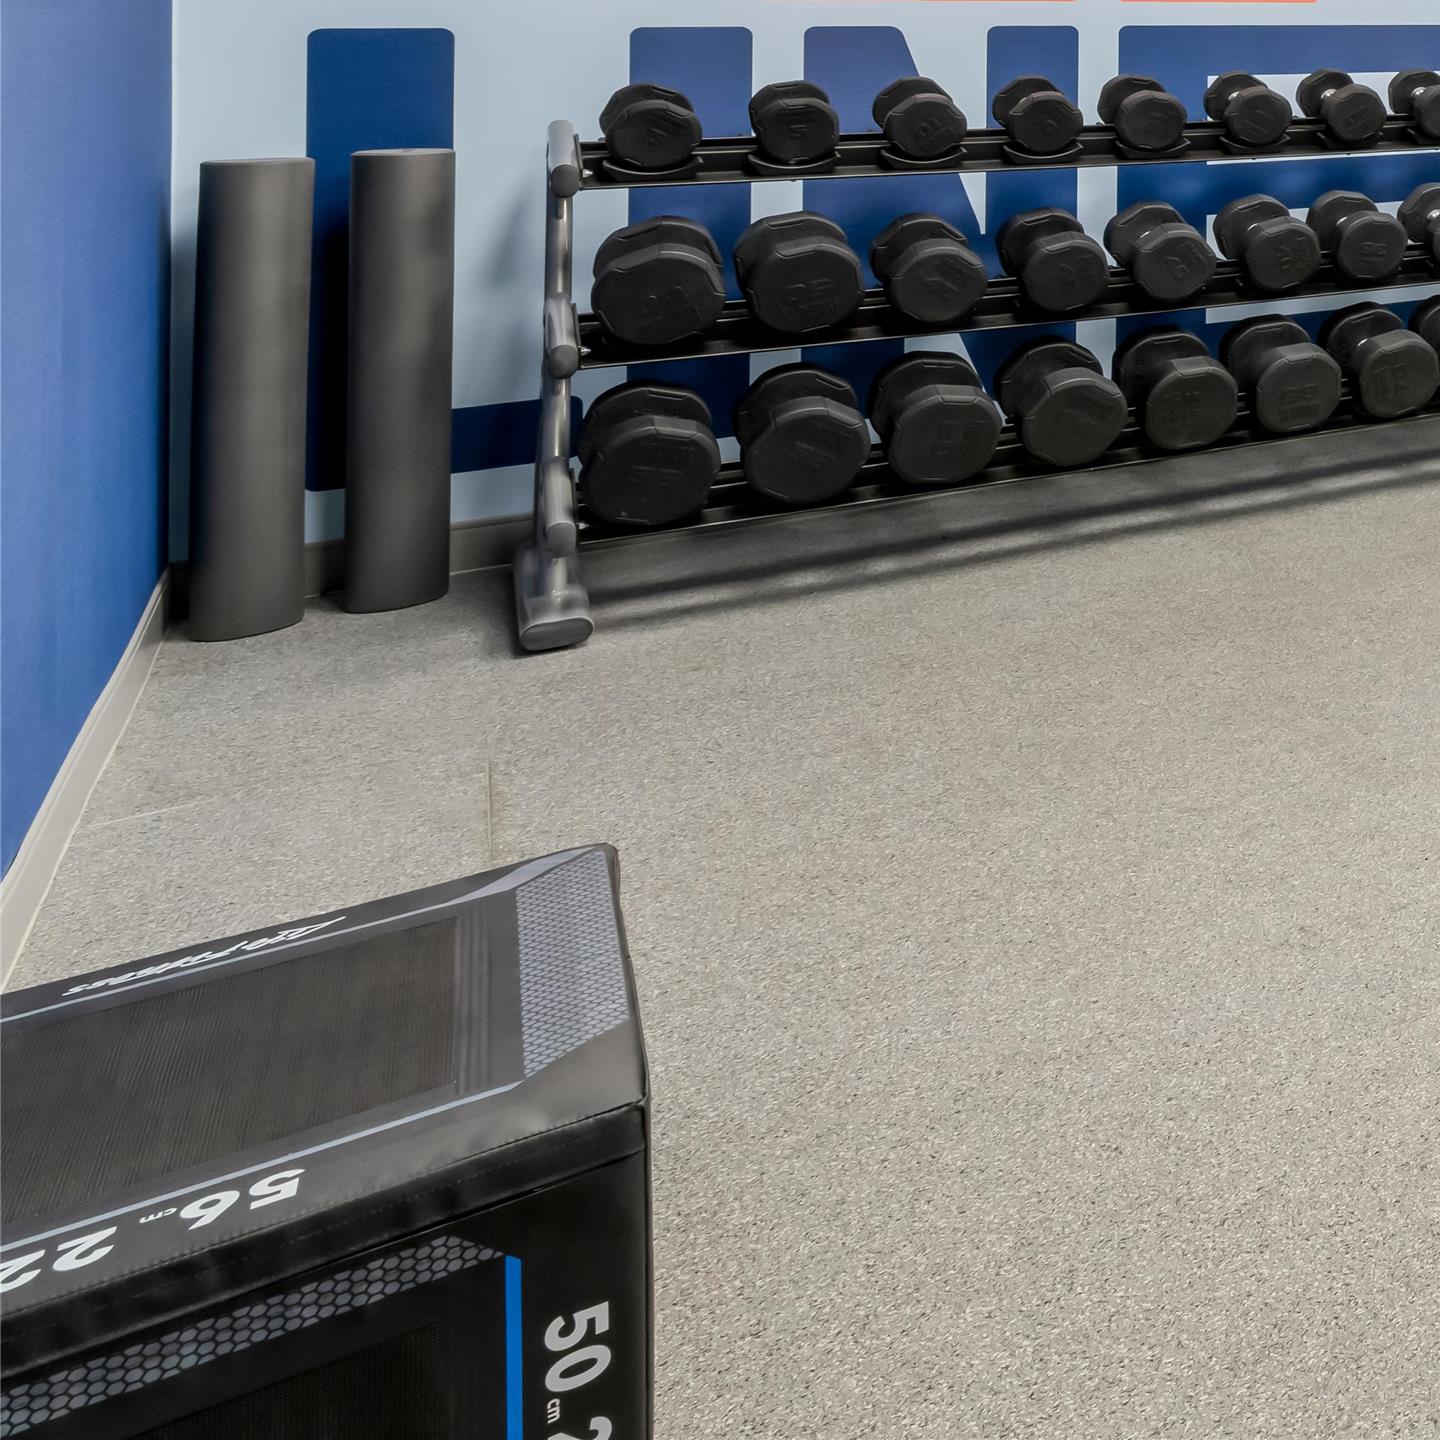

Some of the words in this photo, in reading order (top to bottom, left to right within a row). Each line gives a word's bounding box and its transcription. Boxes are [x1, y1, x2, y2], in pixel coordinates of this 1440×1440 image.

[138, 1207, 178, 1224] cm
[180, 1168, 305, 1232] 56
[544, 1301, 612, 1393] 50
[546, 1398, 561, 1425] cm
